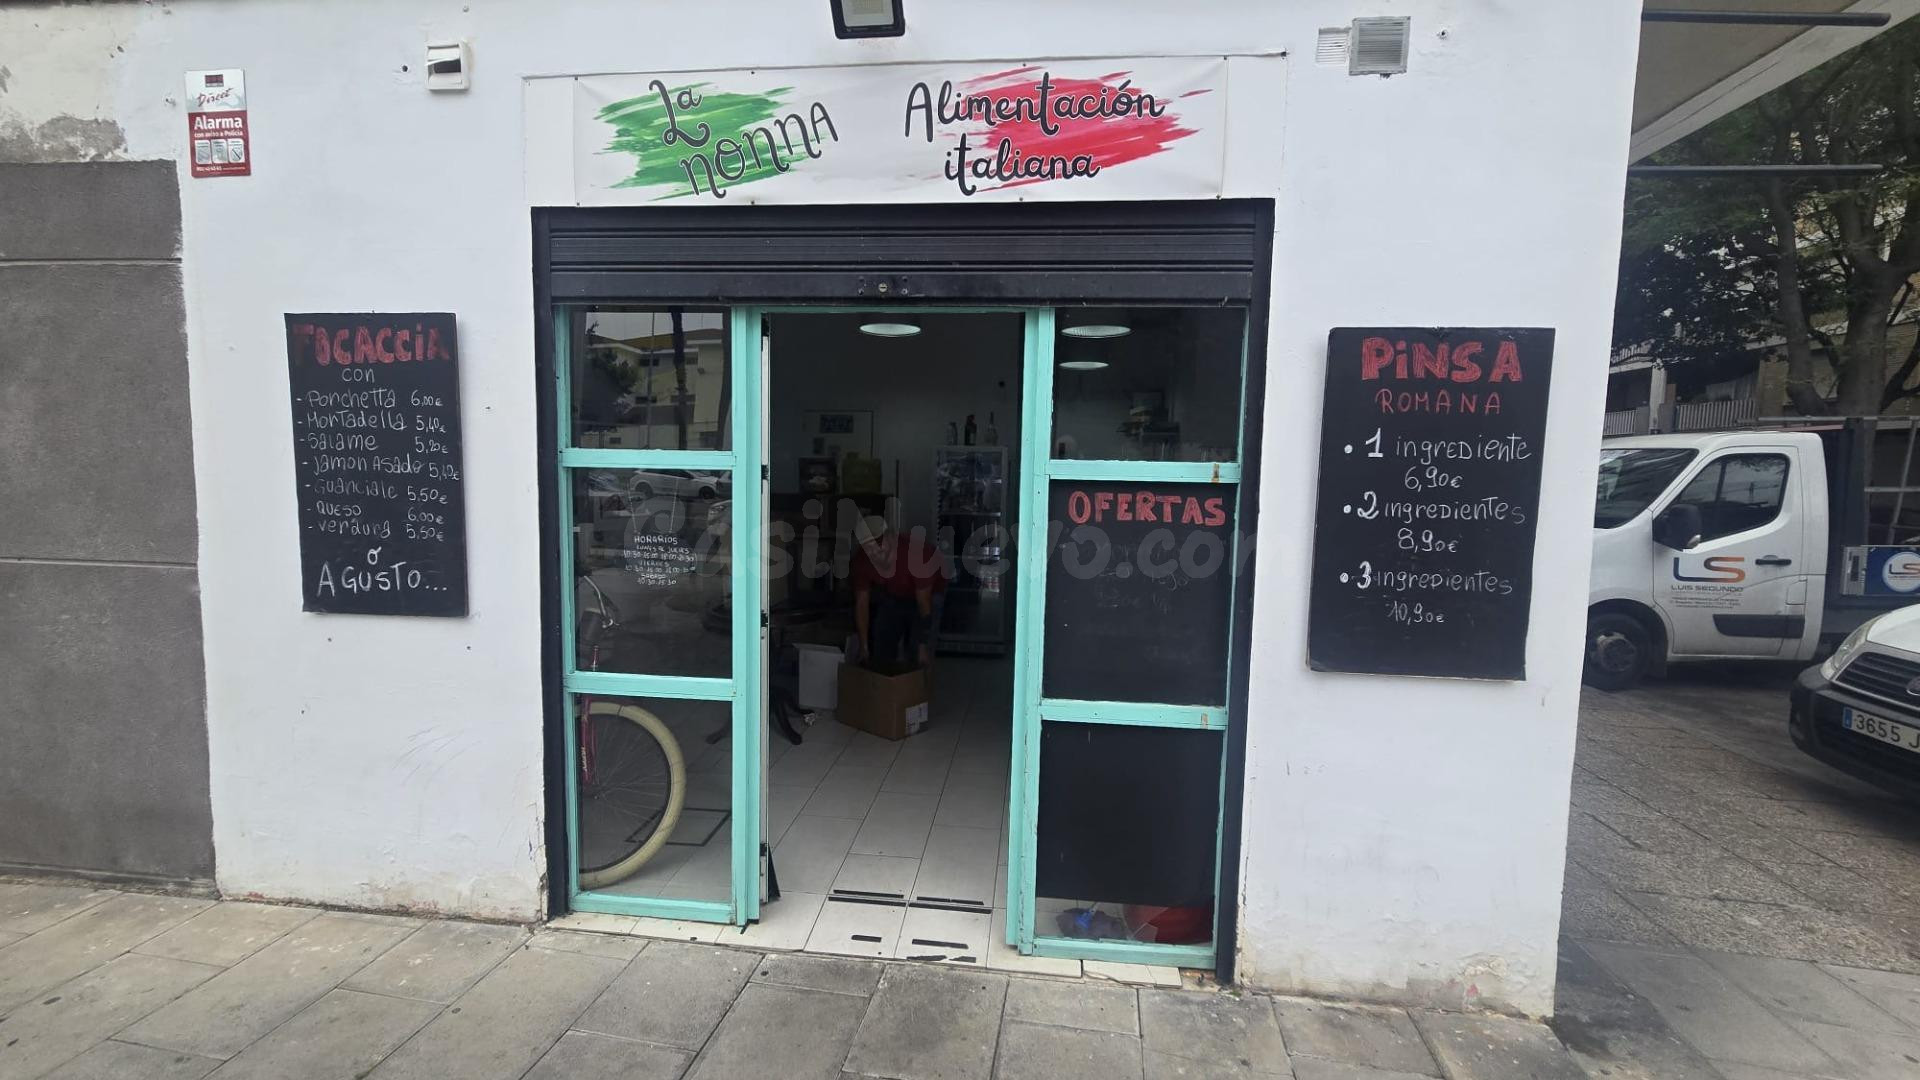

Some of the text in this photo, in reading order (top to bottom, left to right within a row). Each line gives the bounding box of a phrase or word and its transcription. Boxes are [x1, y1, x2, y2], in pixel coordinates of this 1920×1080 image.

[650, 79, 710, 147] La
[905, 72, 1165, 143] Alimentación
[194, 115, 242, 130] Alarma
[944, 133, 1101, 196] italiana
[342, 368, 375, 382] con
[1375, 388, 1501, 415] ROMANA
[1365, 427, 1384, 458] 1
[1404, 466, 1464, 492] 6,90€
[1068, 491, 1226, 526] OFERTAS
[1357, 491, 1380, 519] 2
[1398, 528, 1458, 553] 8,90€
[1357, 561, 1372, 589] 3
[1673, 557, 1745, 583] LS
[1856, 713, 1901, 743] 3655
